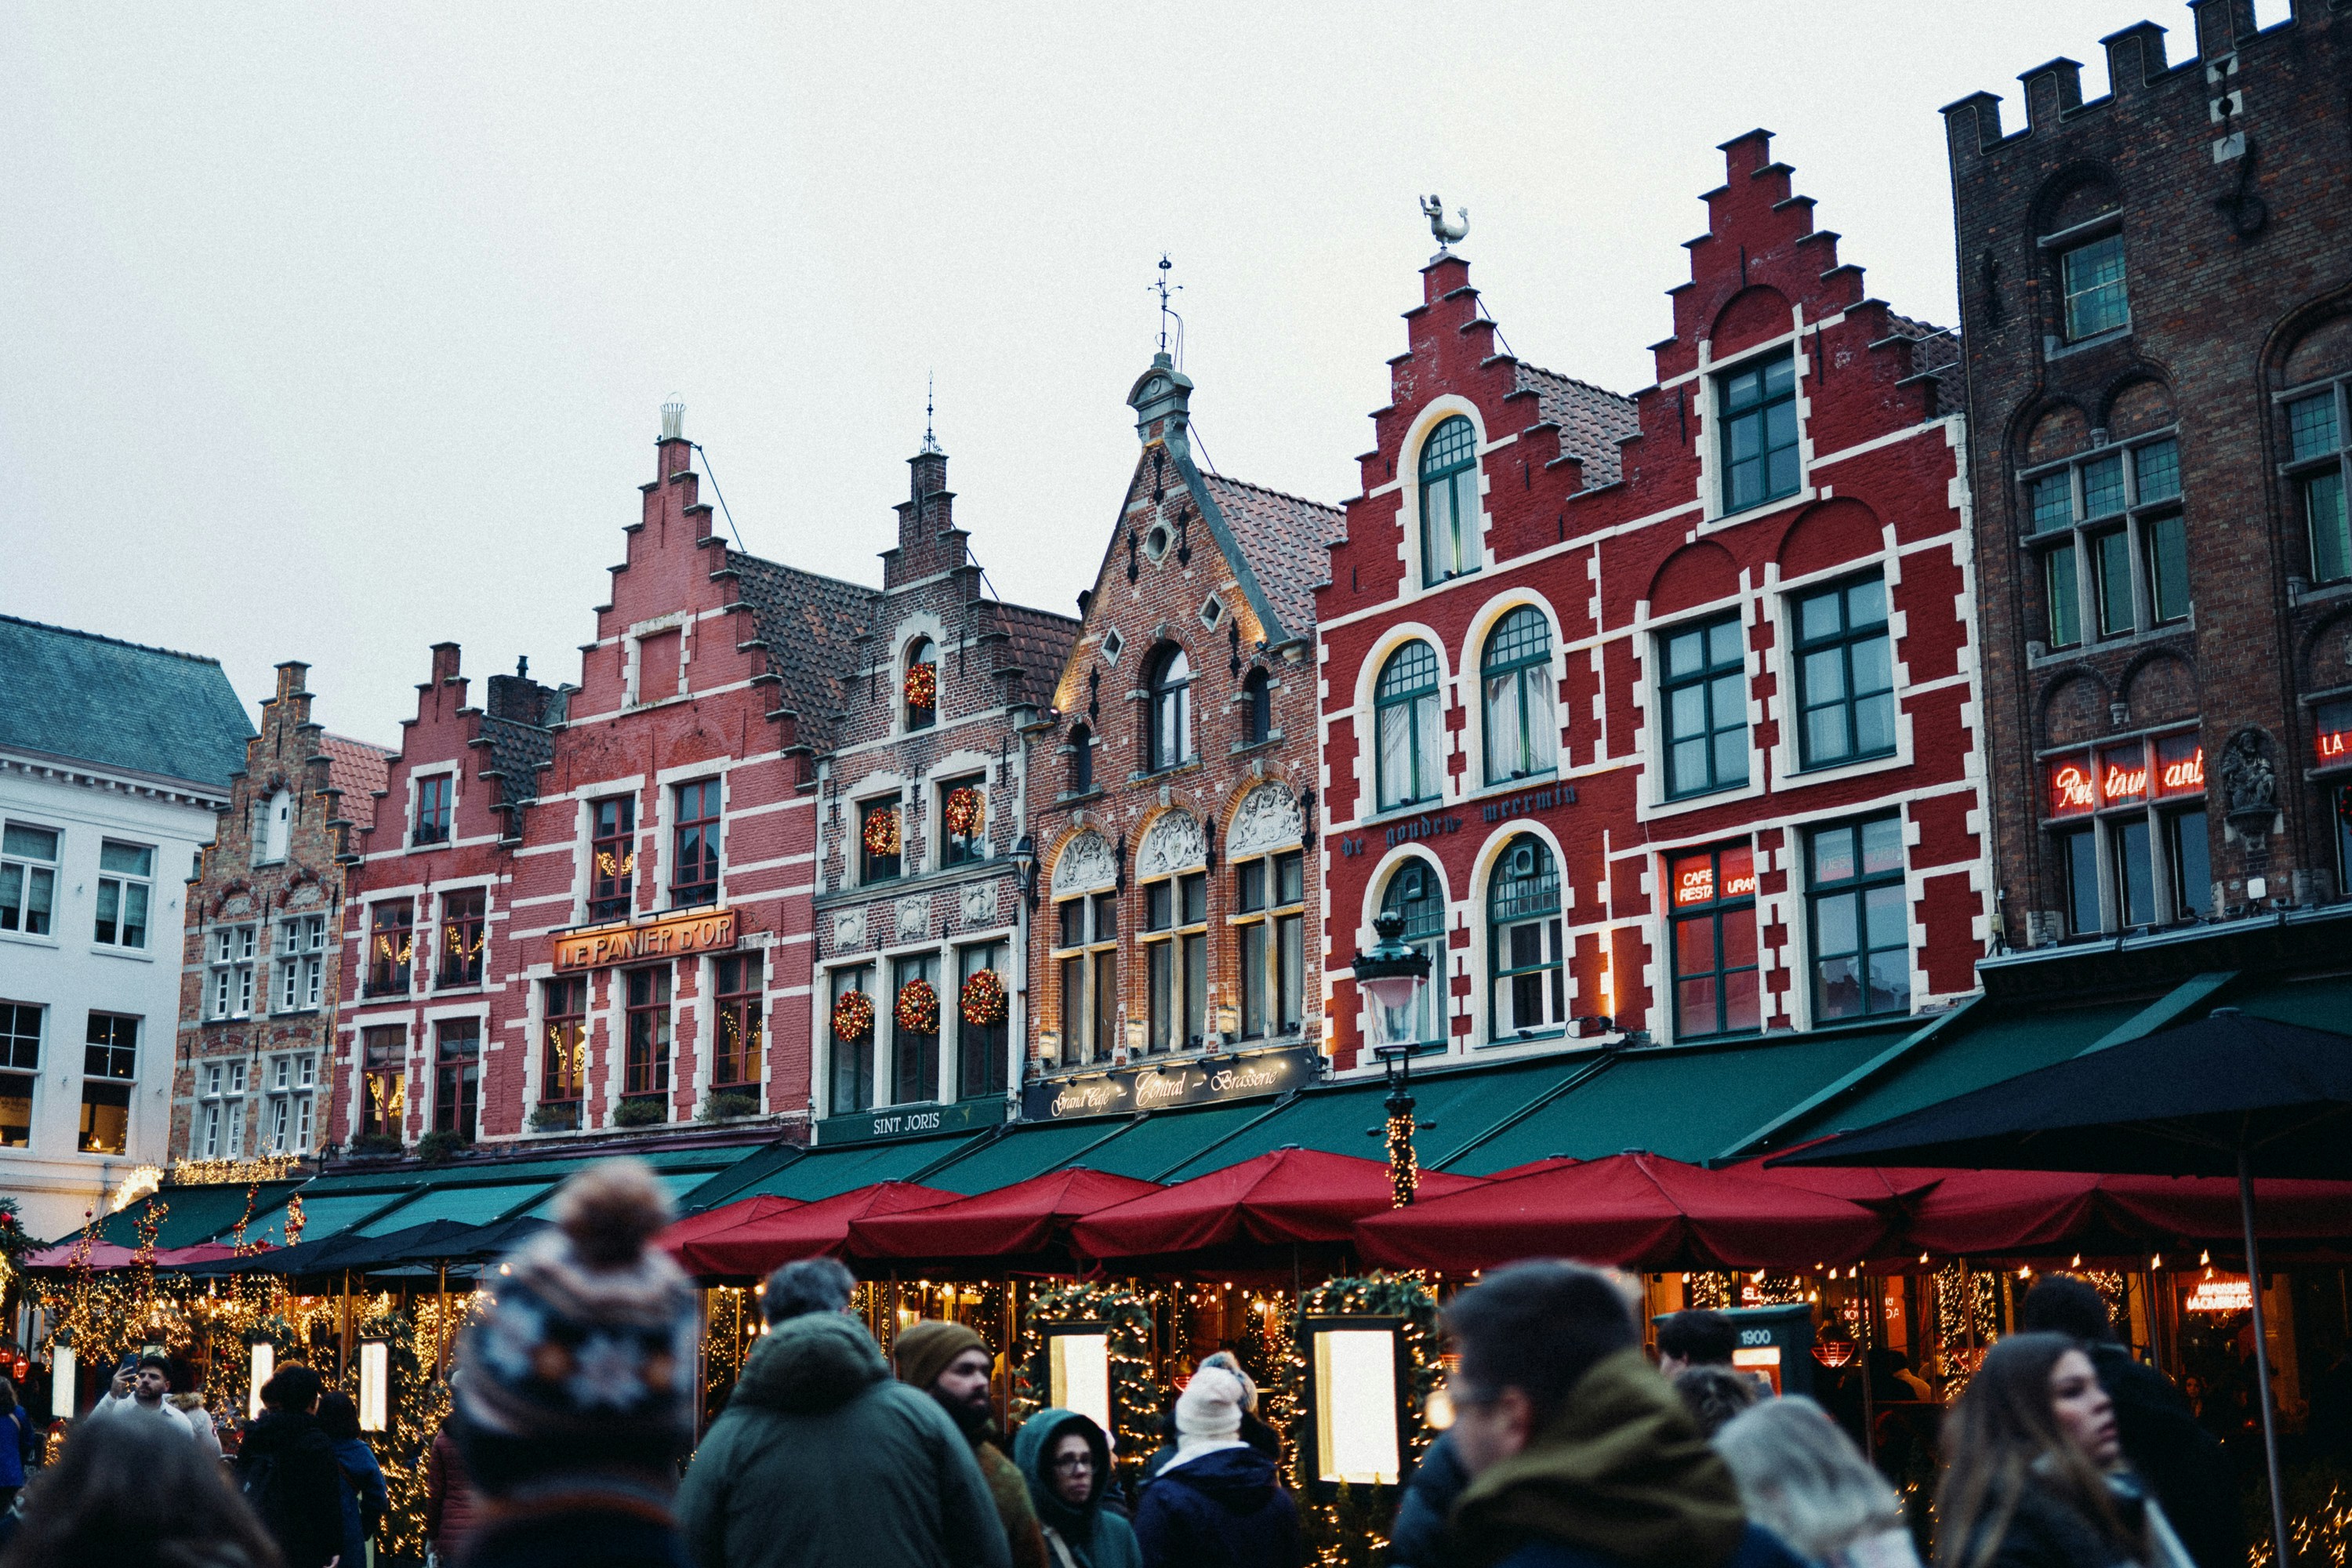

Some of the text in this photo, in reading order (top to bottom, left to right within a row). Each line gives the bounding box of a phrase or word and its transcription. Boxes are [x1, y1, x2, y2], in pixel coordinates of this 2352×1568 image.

[2322, 734, 2344, 754] LA
[1341, 781, 1576, 857] de gouden meermin
[562, 917, 731, 967] LE PANIER D'OR
[1051, 1090, 1087, 1116] Grand
[1135, 1071, 1186, 1106] Central
[1210, 1069, 1278, 1091] Brasserie
[873, 1112, 939, 1134] SINT JORIS
[1741, 1330, 1771, 1345] 1900
